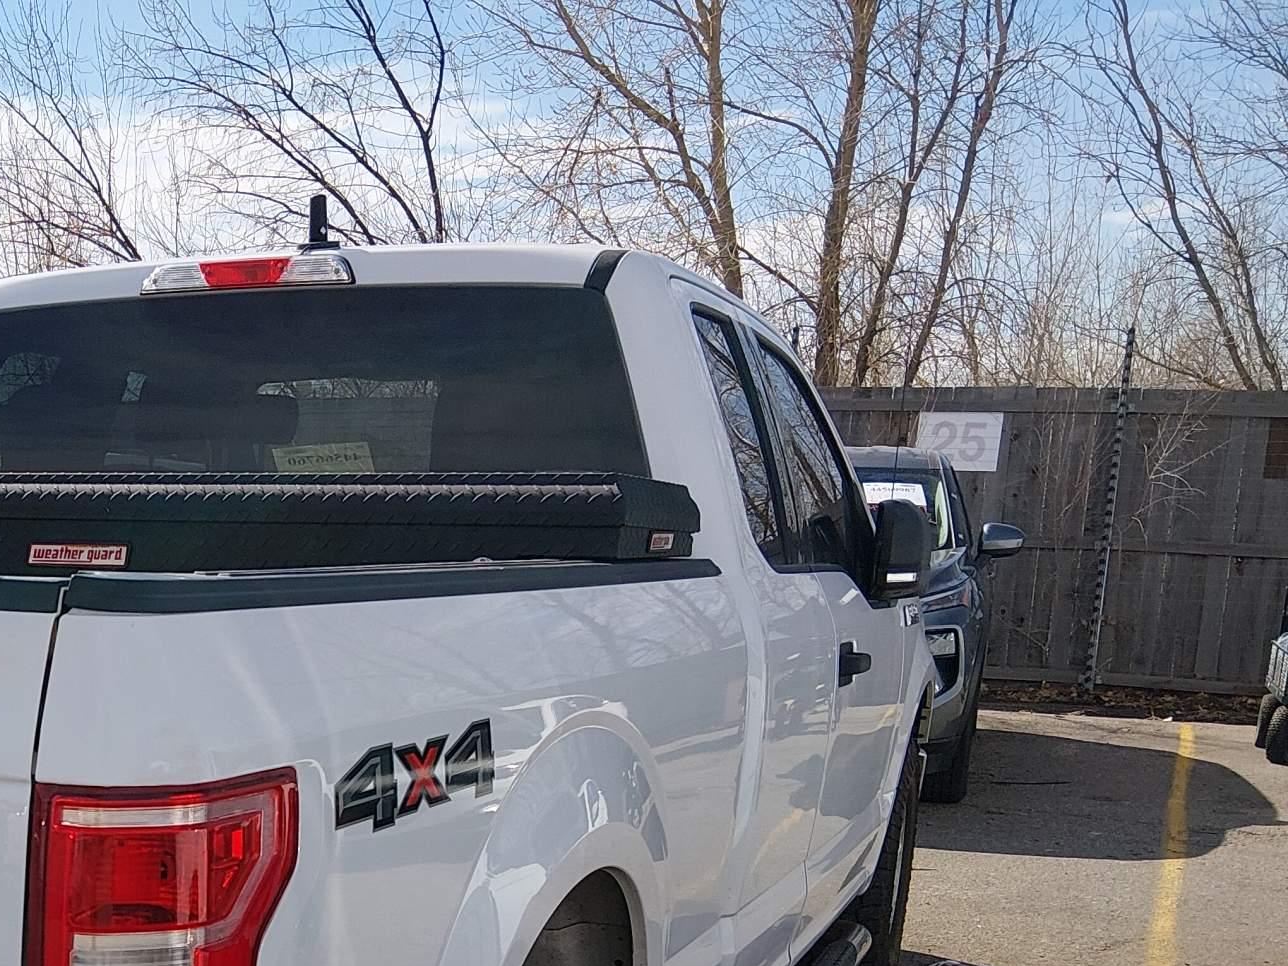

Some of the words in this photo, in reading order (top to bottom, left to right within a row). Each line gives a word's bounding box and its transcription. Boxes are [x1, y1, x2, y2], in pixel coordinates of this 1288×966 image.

[930, 420, 988, 462] 25
[31, 547, 84, 560] weather
[86, 548, 123, 562] guard
